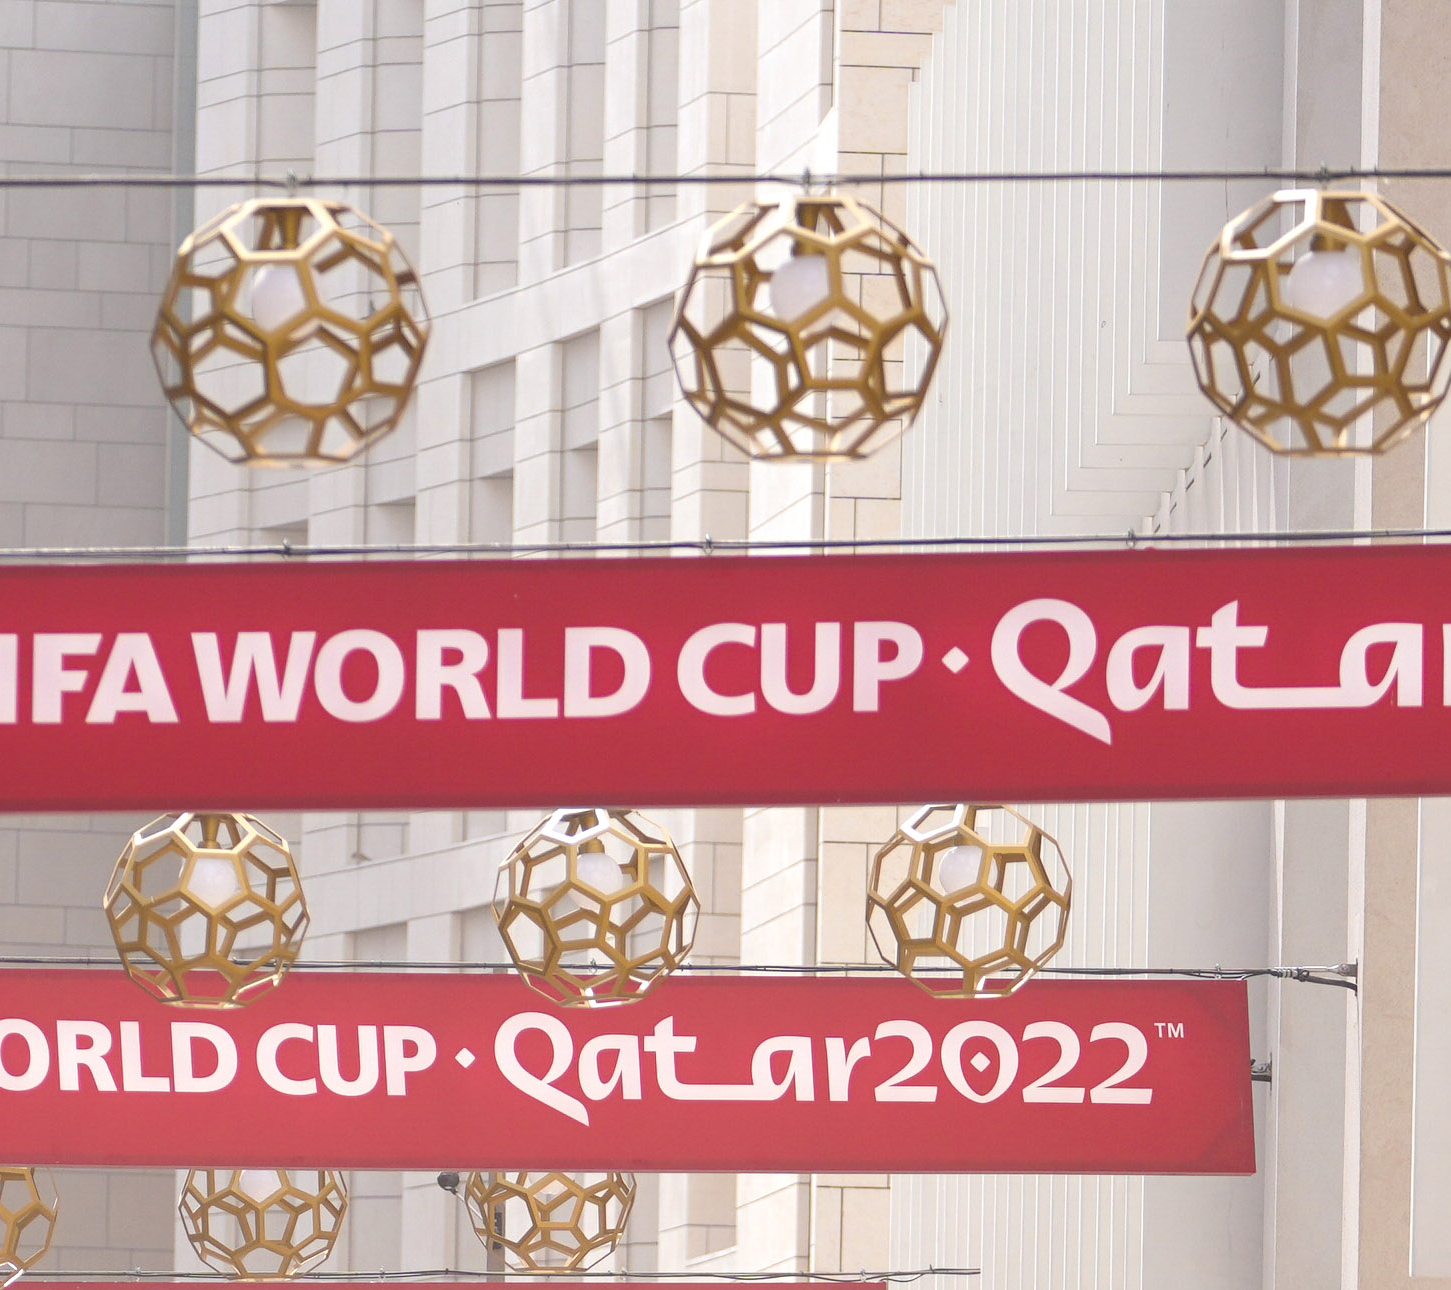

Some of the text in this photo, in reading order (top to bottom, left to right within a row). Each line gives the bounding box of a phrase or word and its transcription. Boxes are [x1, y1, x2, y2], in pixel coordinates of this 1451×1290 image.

[190, 627, 651, 723] WORLD
[677, 621, 924, 718] CUP
[256, 1022, 437, 1097] CUP
